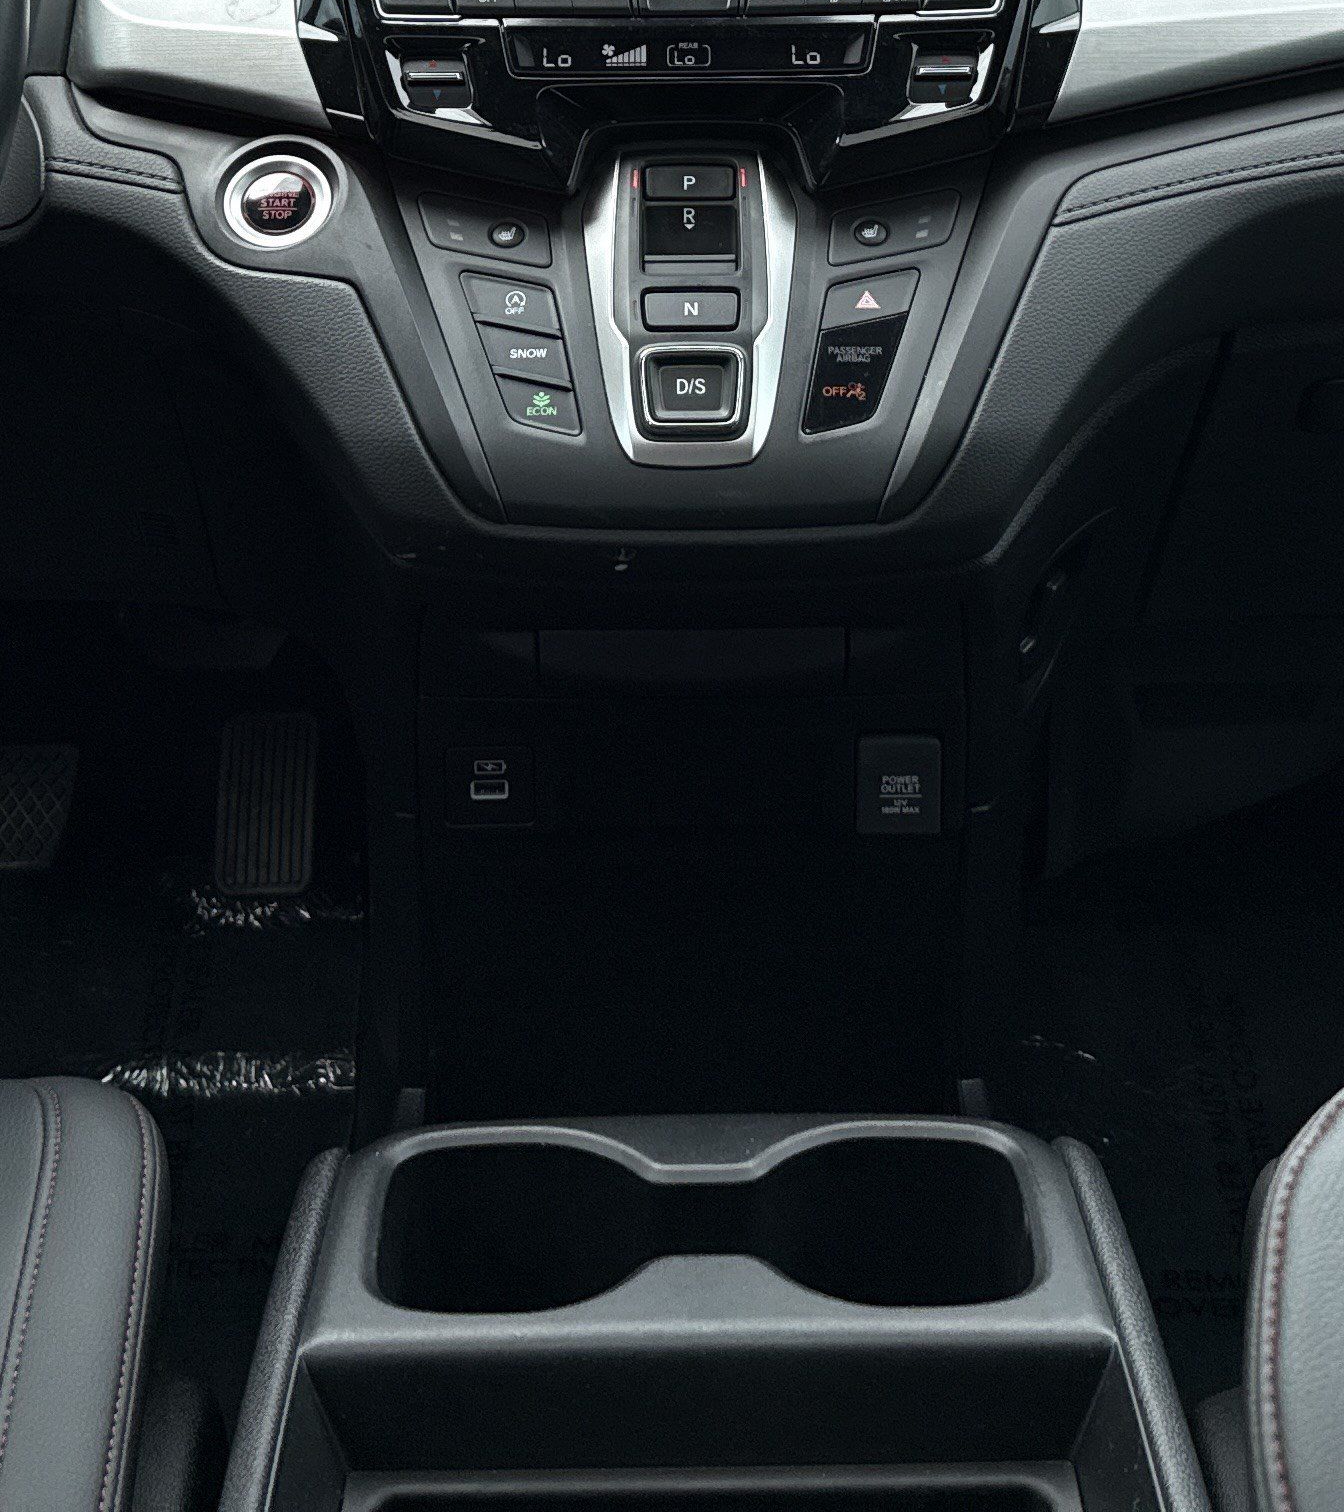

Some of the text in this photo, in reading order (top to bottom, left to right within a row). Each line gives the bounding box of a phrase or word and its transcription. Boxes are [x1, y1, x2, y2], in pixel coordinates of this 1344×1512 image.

[542, 47, 572, 67] Lo
[674, 50, 695, 65] Lo
[791, 44, 821, 65] Lo
[682, 175, 696, 191] P
[260, 198, 297, 207] START
[262, 210, 293, 220] STOP
[683, 208, 696, 224] R
[505, 306, 525, 315] OFF
[683, 301, 699, 316] N
[509, 348, 548, 359] SNOW
[827, 346, 883, 355] PASSENGER
[836, 354, 871, 363] AIRBAG
[676, 378, 706, 395] D/S
[822, 386, 847, 397] OFF
[526, 406, 557, 416] ECON
[881, 775, 919, 784] POWER
[880, 784, 921, 793] OUTLET
[902, 806, 920, 814] MAX
